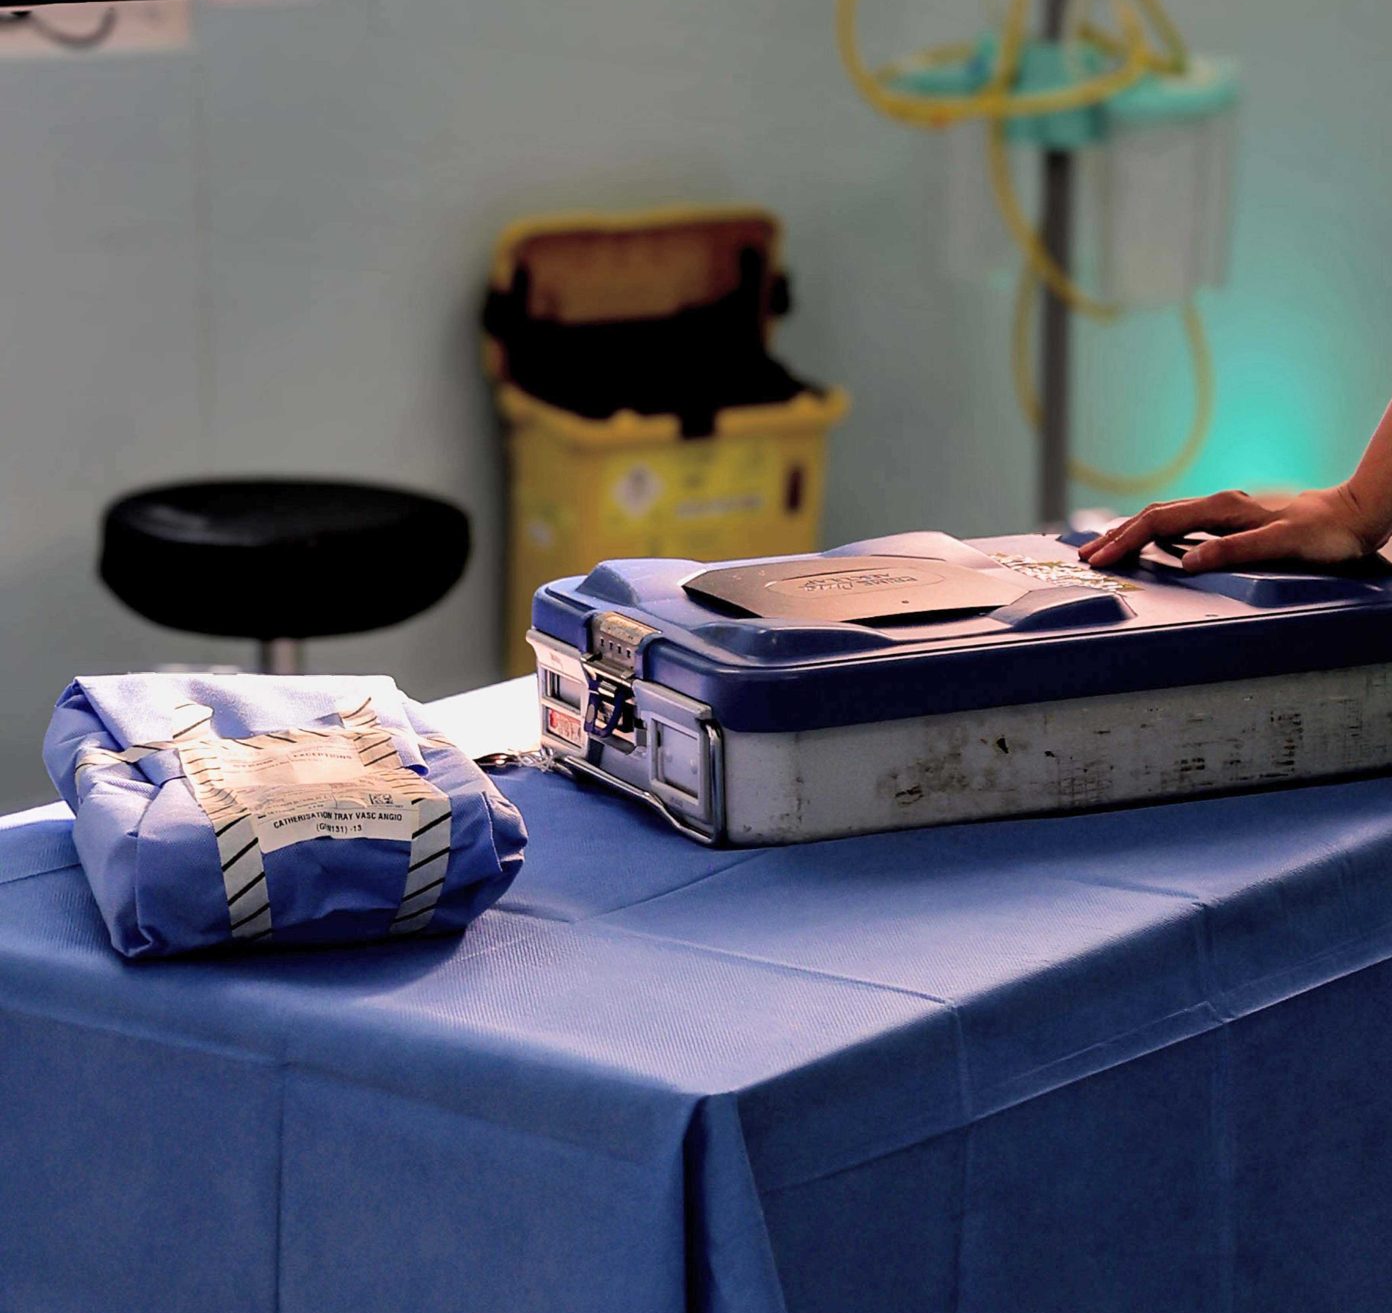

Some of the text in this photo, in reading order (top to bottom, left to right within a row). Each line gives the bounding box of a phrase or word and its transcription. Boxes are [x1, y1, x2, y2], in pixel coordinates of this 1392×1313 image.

[273, 810, 403, 829] CATHERISATION TRAY VASC ANGIO
